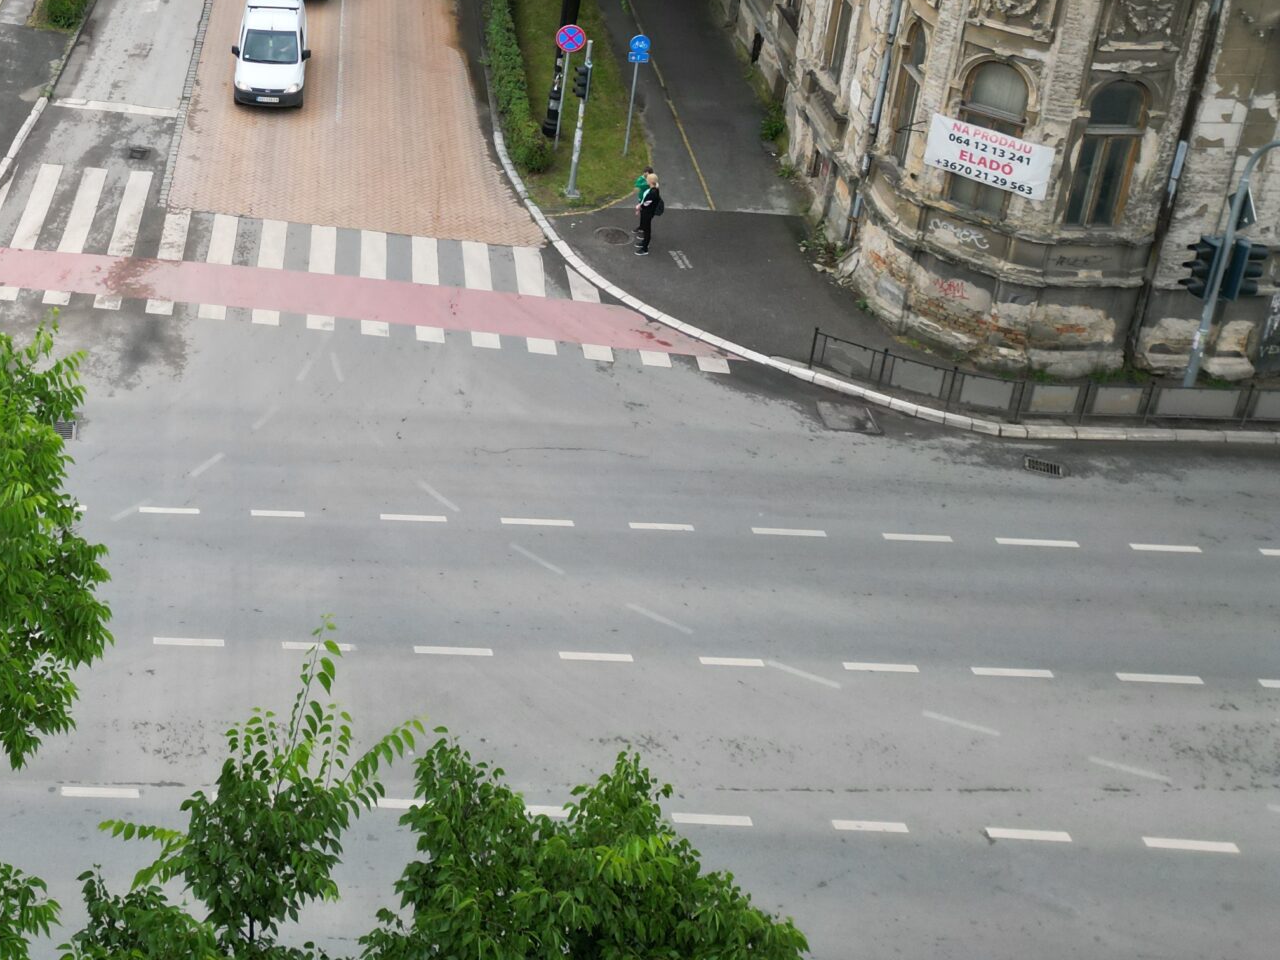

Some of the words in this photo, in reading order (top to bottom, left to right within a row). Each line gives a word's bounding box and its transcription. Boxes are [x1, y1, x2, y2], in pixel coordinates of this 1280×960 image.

[948, 133, 971, 147] 064
[974, 141, 988, 152] 12
[992, 146, 1006, 158] 13
[1009, 152, 1031, 166] 241
[952, 121, 971, 136] NA
[973, 129, 1033, 154] PRODAJU
[934, 158, 972, 175] +3670
[974, 169, 989, 181] 21
[992, 175, 1007, 187] 29
[1010, 181, 1033, 195] 563
[958, 149, 1014, 176] ELADÓ
